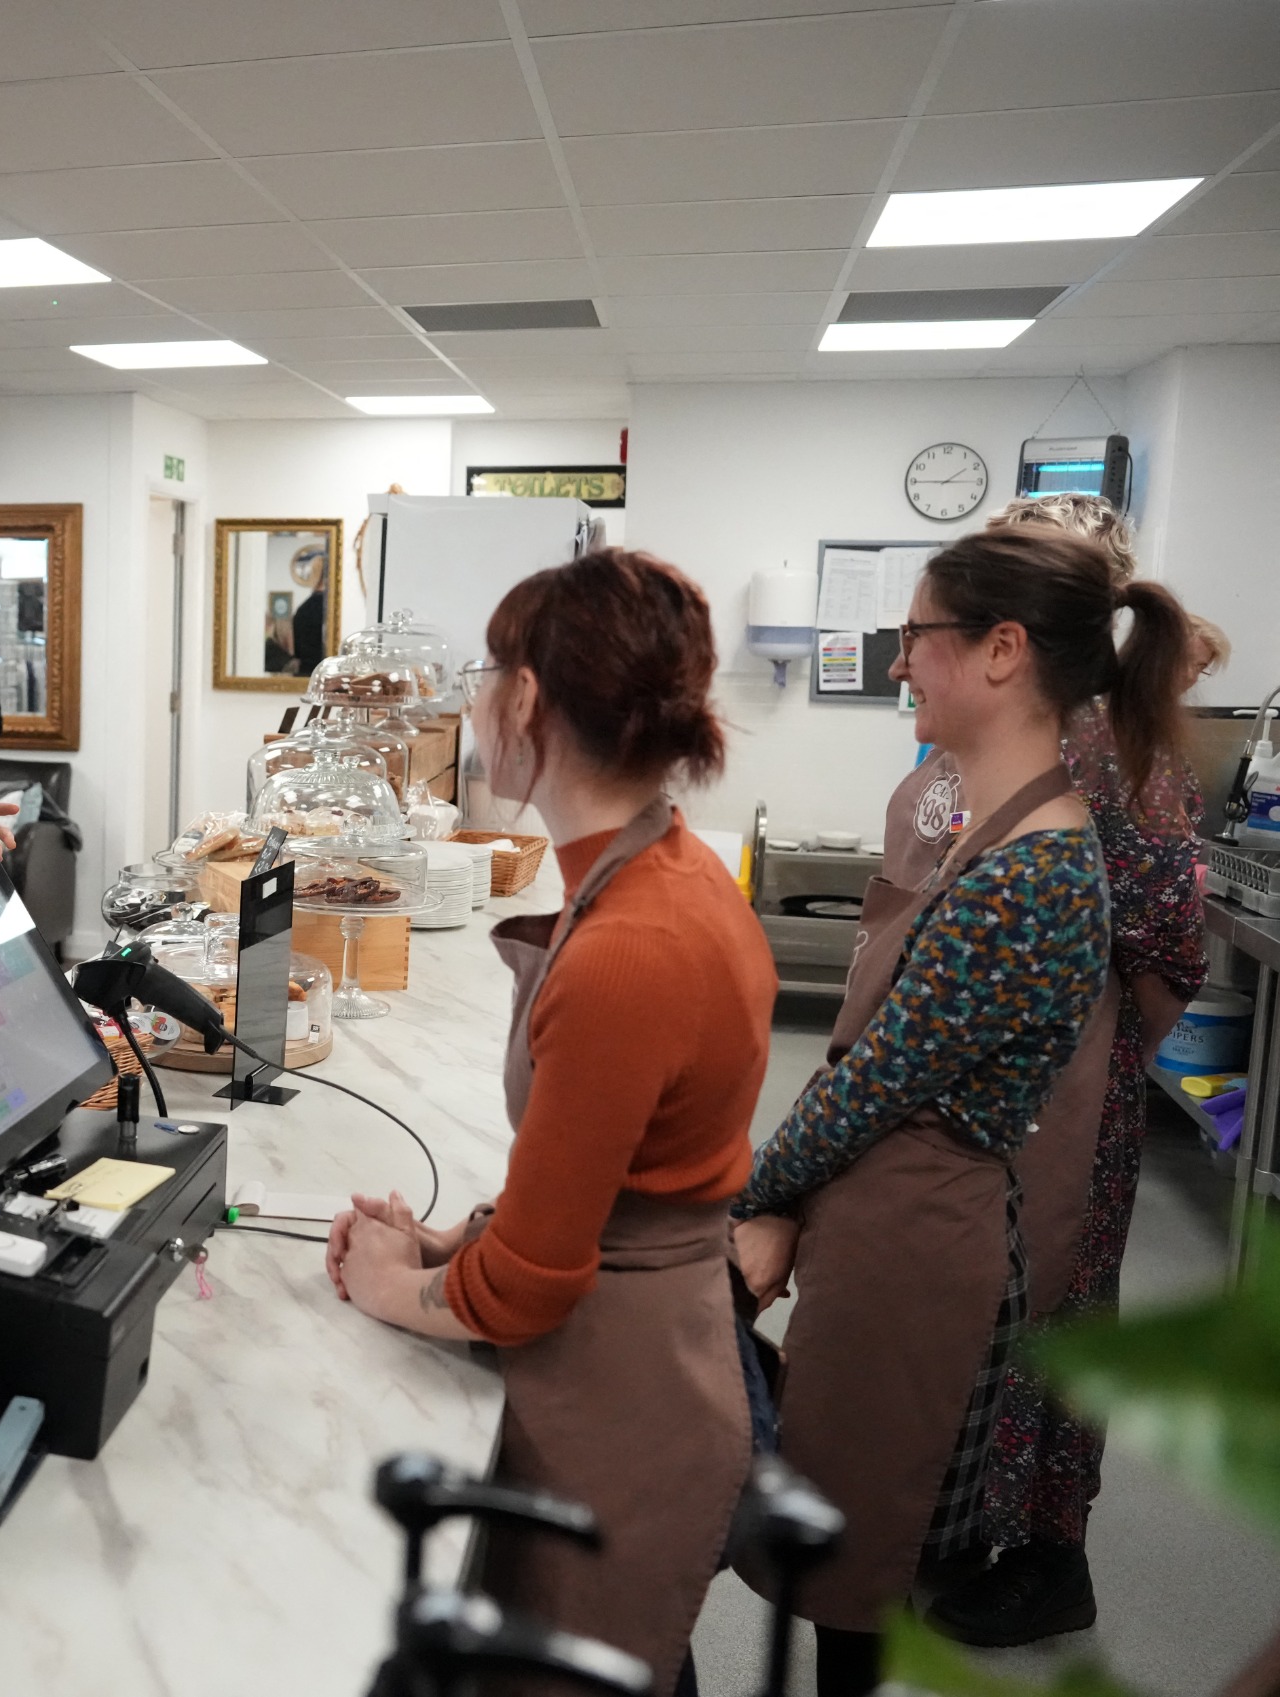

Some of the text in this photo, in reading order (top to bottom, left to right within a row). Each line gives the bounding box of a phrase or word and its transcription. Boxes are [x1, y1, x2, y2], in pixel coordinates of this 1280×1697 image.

[943, 446, 953, 454] 12
[963, 451, 967, 459] 1
[915, 463, 925, 471] 10
[973, 463, 980, 471] 2
[910, 477, 917, 485] 9
[976, 477, 983, 486] 3
[494, 475, 605, 498] TOILETS
[913, 493, 920, 501] 8
[970, 493, 977, 501] 4
[925, 504, 931, 512] 7
[958, 504, 965, 512] 5
